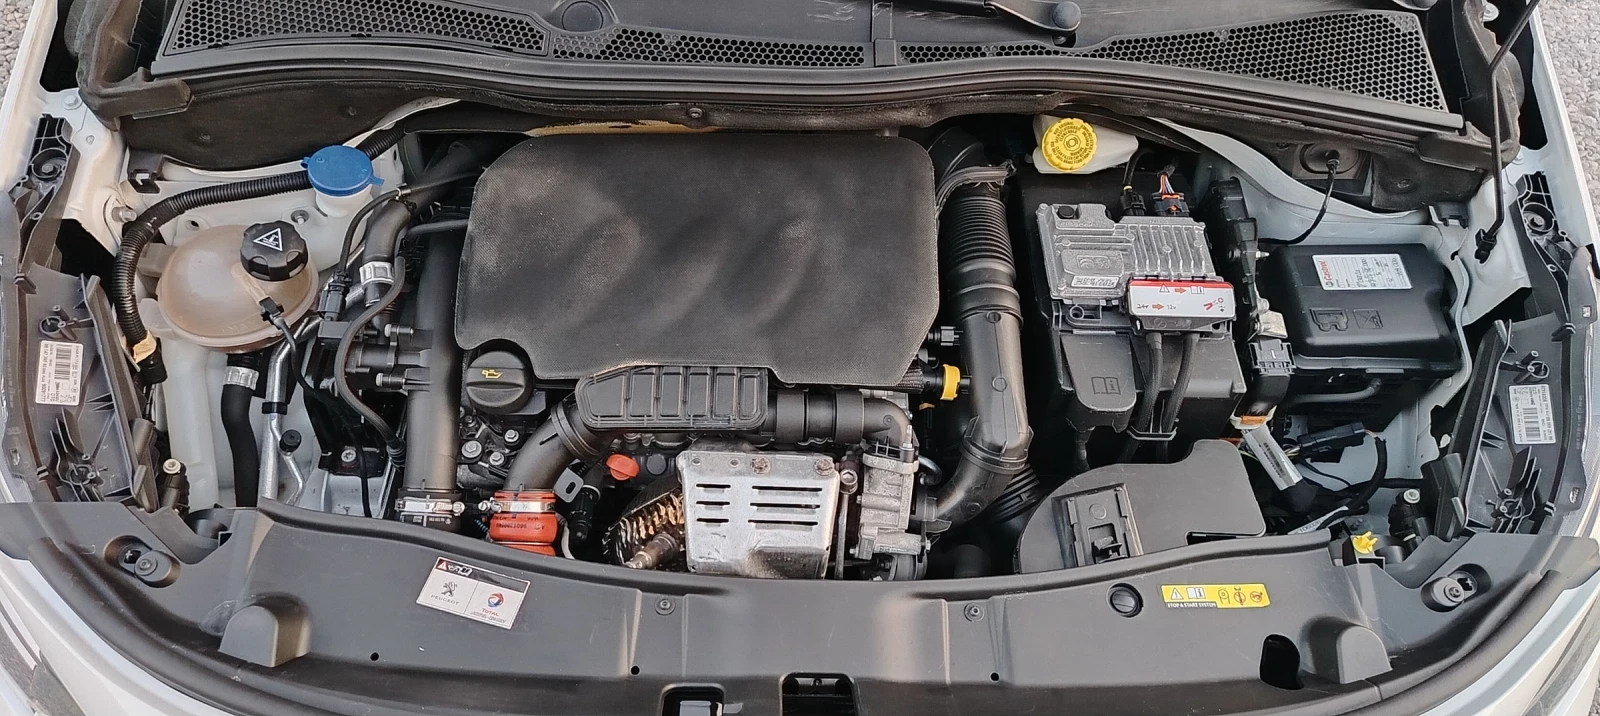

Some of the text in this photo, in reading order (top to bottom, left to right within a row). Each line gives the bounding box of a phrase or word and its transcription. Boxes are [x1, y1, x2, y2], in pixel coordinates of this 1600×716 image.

[1319, 260, 1332, 281] Castrol
[431, 594, 459, 605] PEUGEOT
[482, 608, 499, 616] TOTAL
